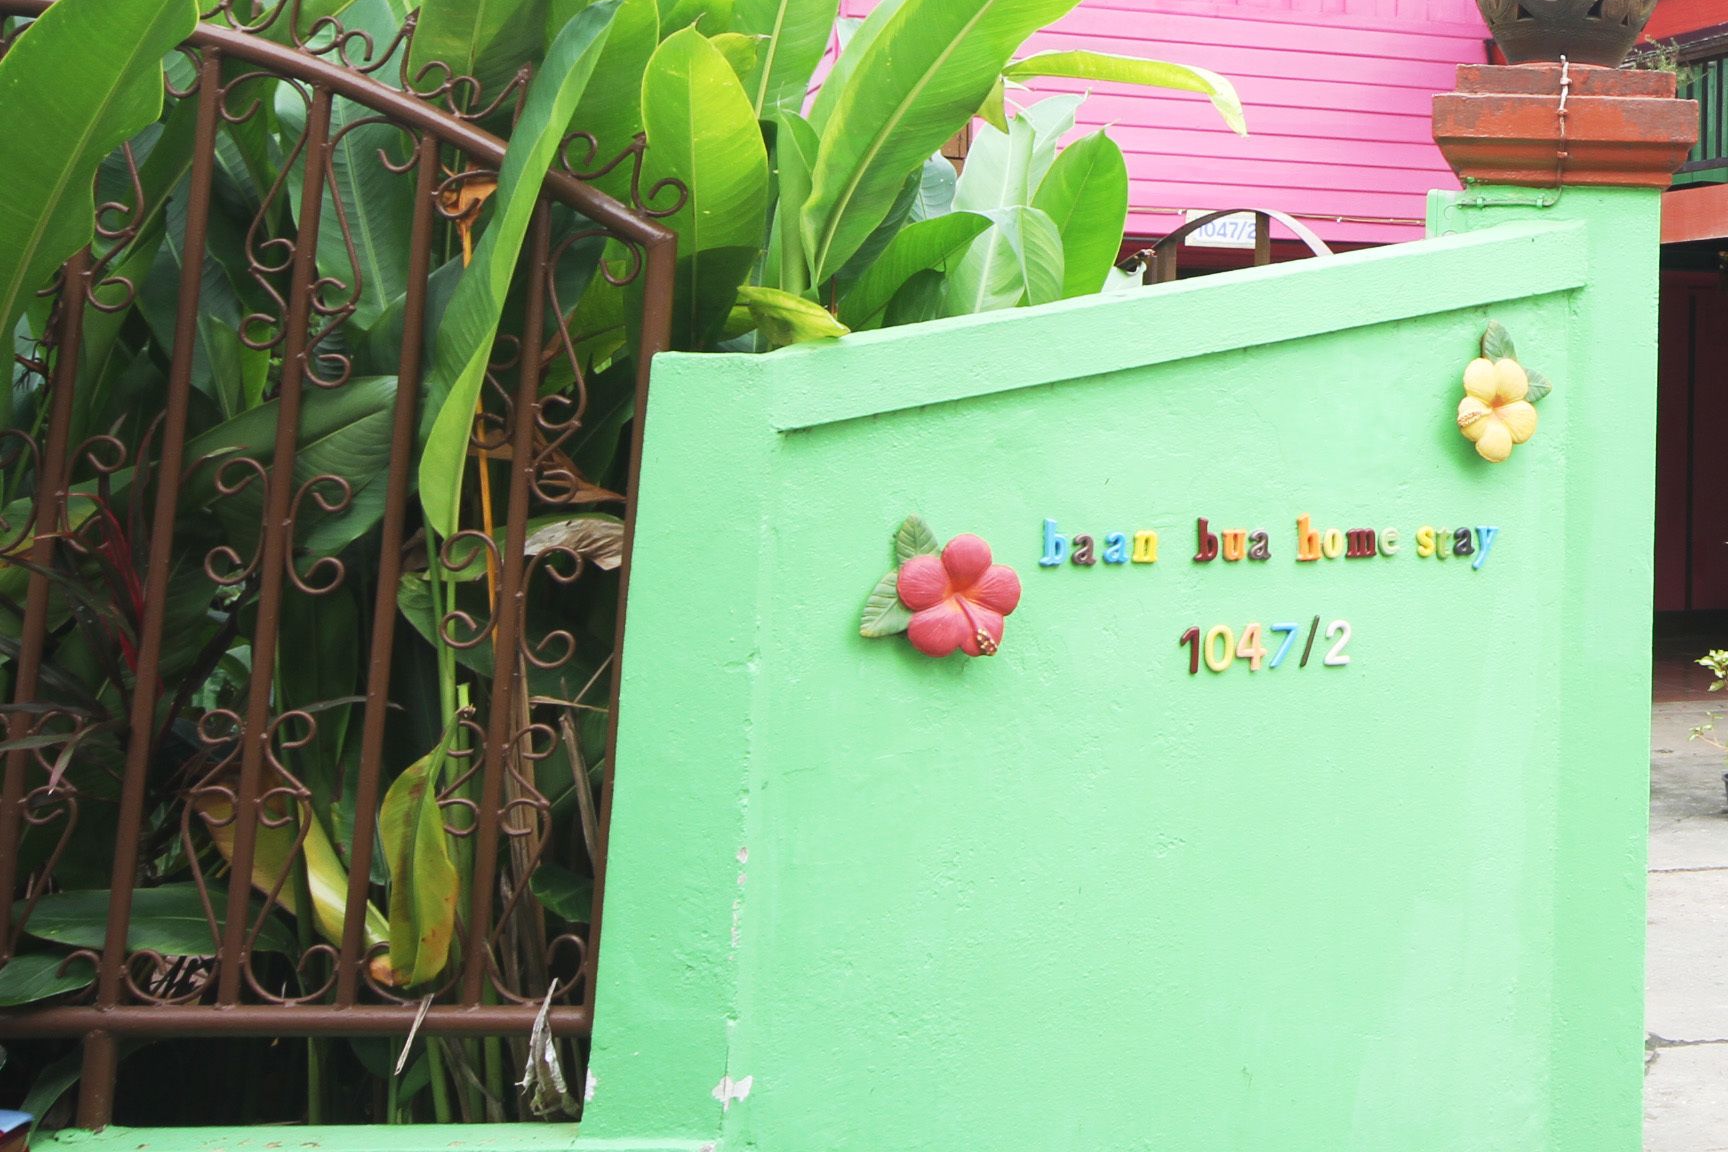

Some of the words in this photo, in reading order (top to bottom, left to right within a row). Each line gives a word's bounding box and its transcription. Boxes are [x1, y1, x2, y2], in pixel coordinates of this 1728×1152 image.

[1039, 517, 1158, 567] baan
[1193, 516, 1271, 563] bua
[1296, 512, 1400, 562] home
[1416, 524, 1500, 570] stay
[1180, 615, 1352, 674] 1047/2
